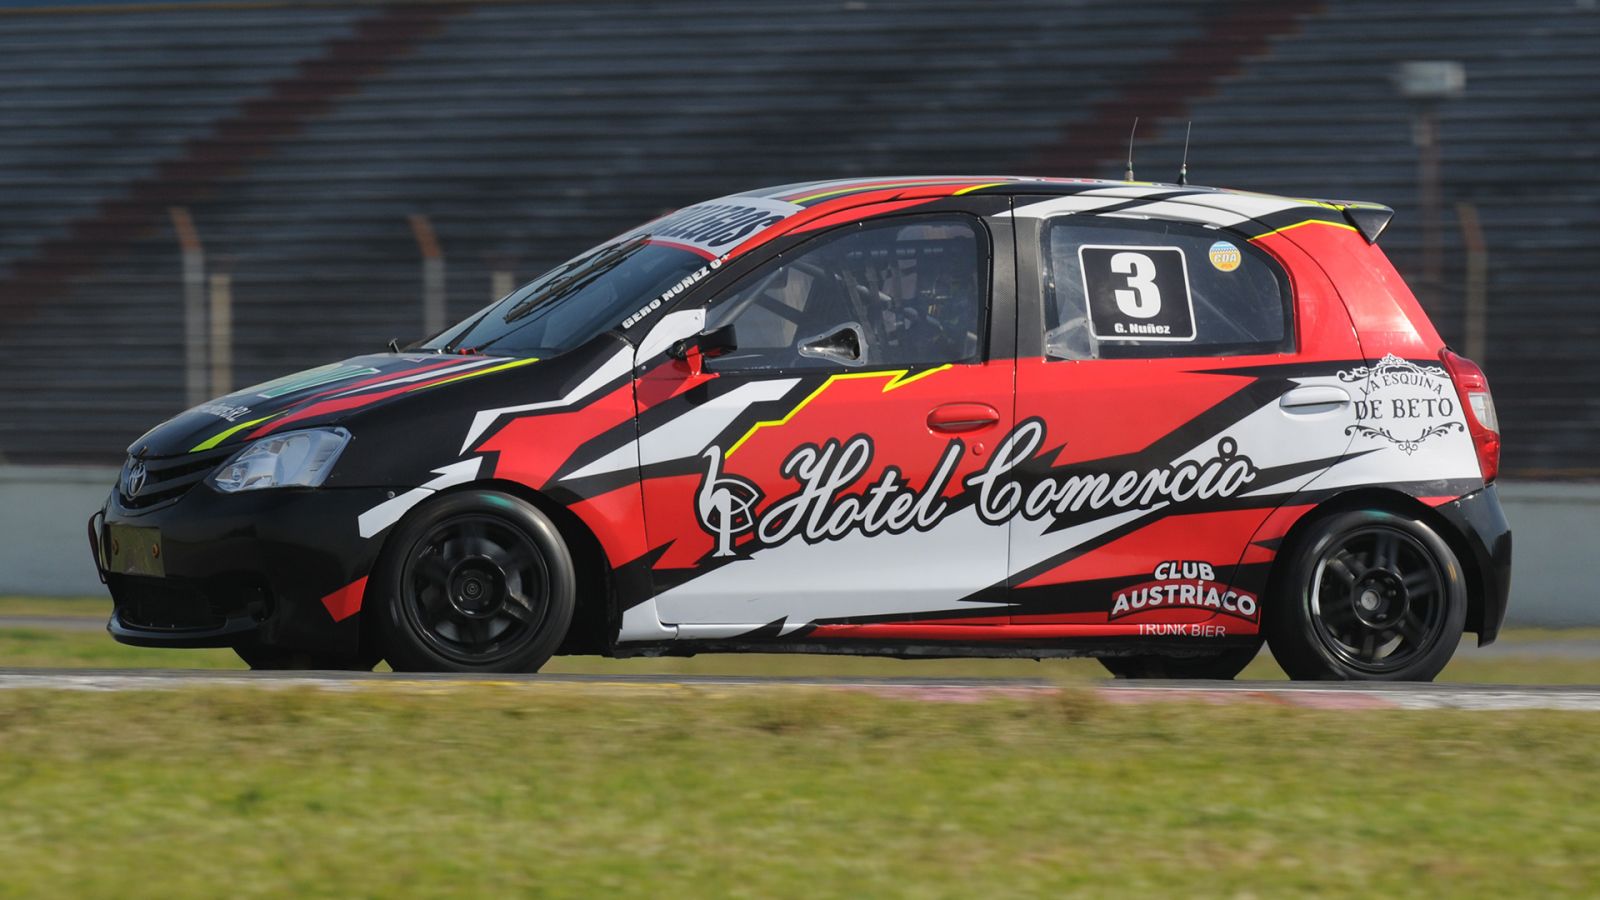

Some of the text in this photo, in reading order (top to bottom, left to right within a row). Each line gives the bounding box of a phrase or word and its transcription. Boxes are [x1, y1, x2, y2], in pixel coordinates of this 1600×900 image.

[1110, 252, 1162, 319] 3
[621, 298, 662, 330] GERO
[1114, 322, 1128, 334] G.
[1359, 373, 1443, 396] LA ESQUINA
[1354, 398, 1453, 421] DE BETO
[758, 421, 1256, 544] Hotel Comercio
[1154, 562, 1215, 581] CLUB
[1137, 623, 1227, 637] TRUNK BIER
